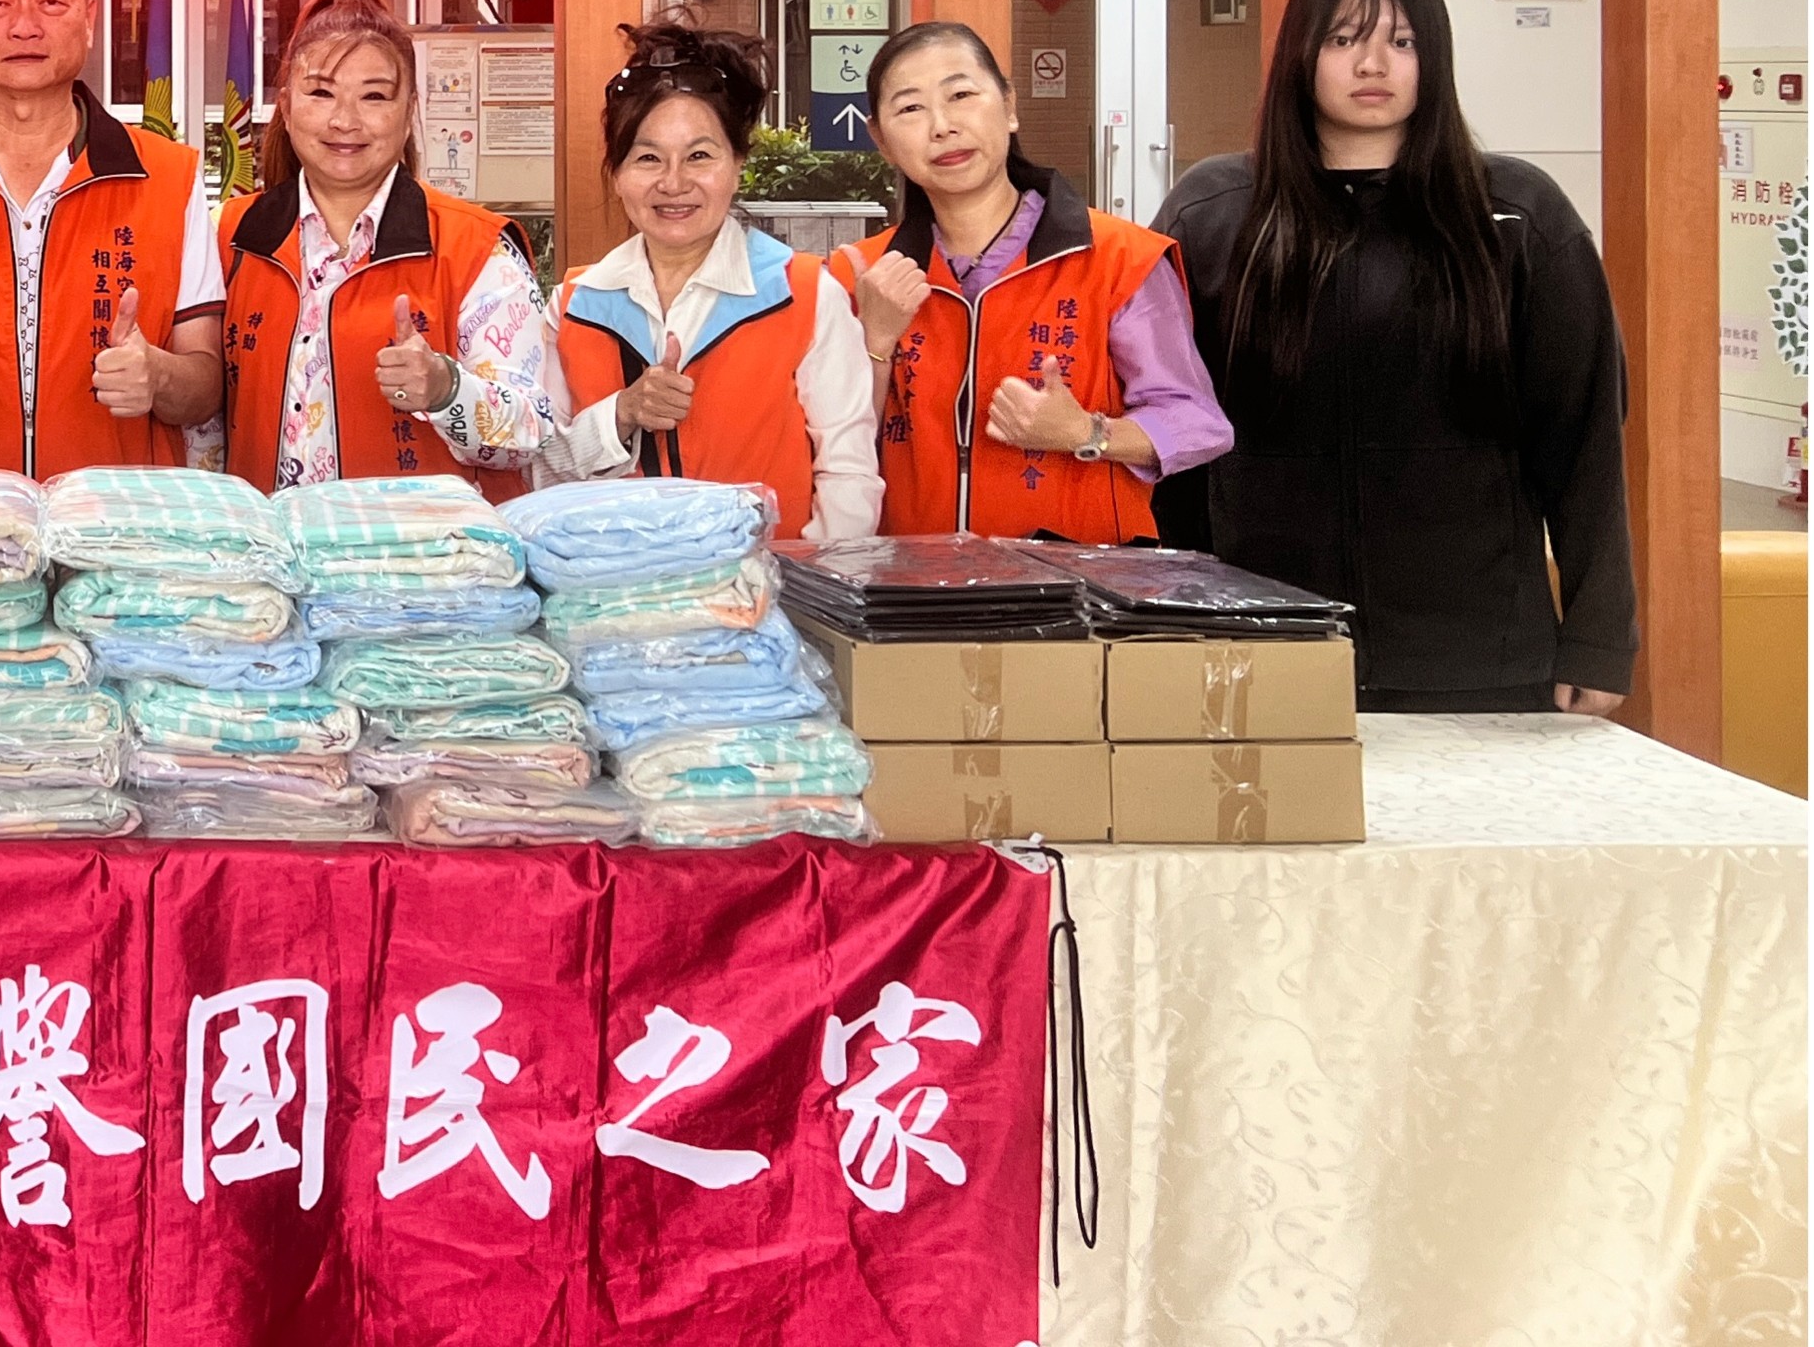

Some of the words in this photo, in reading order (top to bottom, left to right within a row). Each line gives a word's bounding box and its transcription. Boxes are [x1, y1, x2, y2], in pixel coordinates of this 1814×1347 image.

[1731, 179, 1794, 205] 消防栓
[484, 302, 531, 358] Barbie
